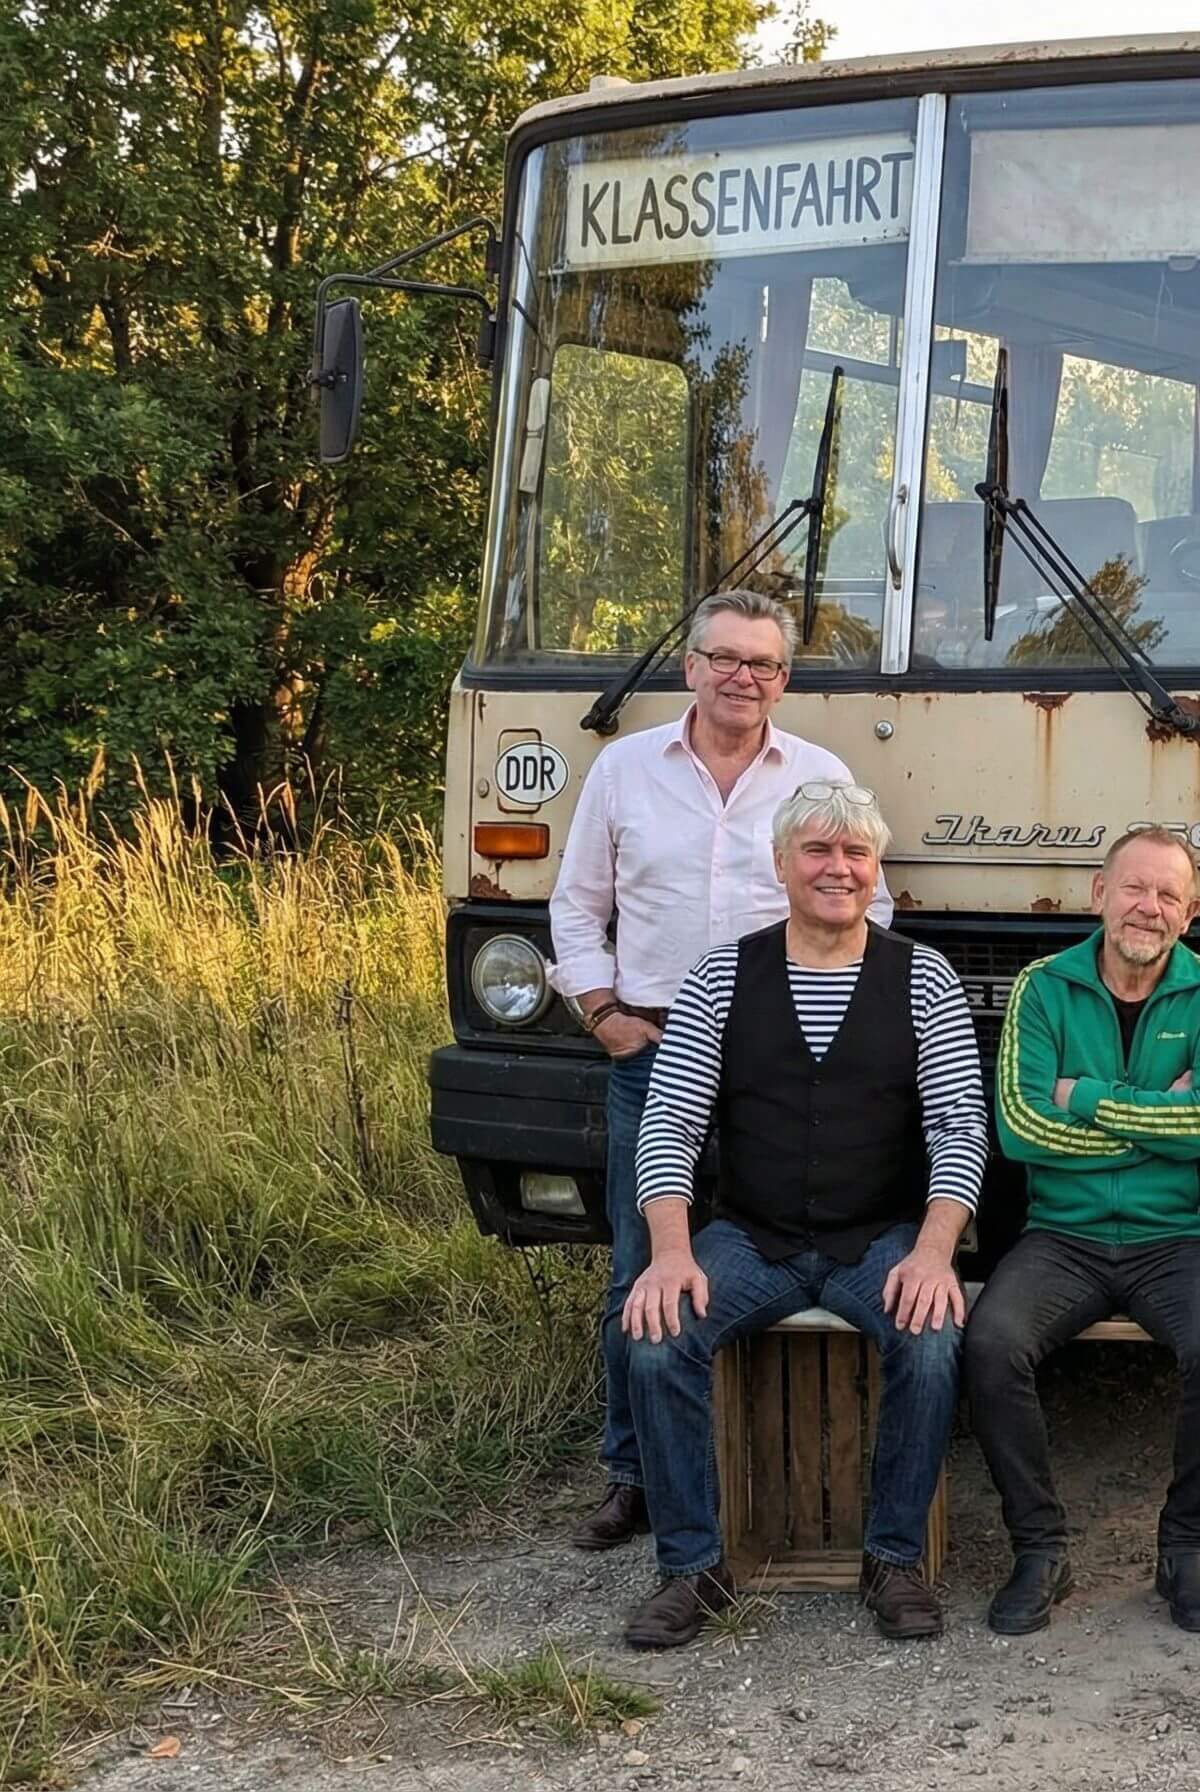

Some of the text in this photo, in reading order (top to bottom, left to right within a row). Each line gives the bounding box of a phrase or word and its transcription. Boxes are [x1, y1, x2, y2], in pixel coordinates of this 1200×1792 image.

[580, 152, 913, 247] KLASSENFAHRT
[505, 755, 556, 791] DDR
[922, 815, 1106, 848] Ikarus
